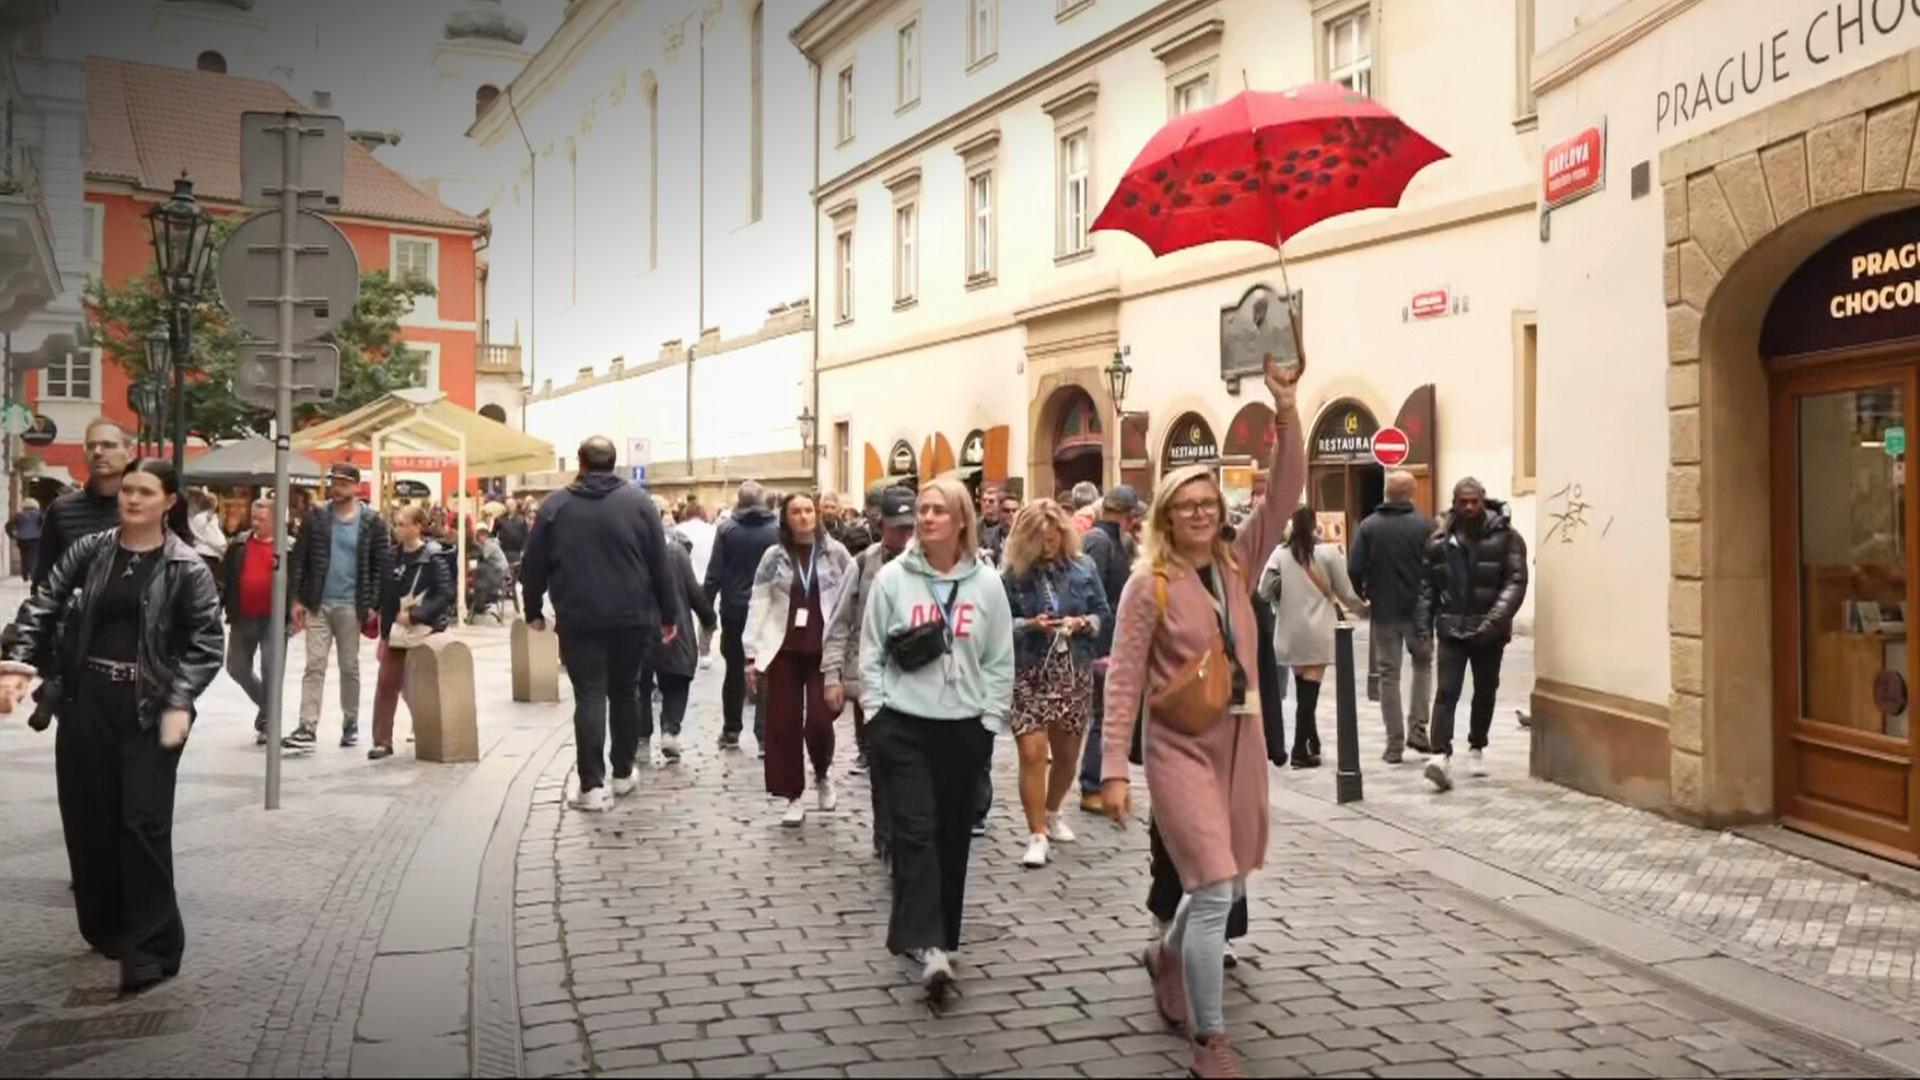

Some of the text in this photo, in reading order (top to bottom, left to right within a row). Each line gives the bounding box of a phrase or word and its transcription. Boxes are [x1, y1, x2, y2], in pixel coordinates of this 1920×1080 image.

[1656, 30, 1790, 133] PRAGUE
[1851, 242, 1920, 280] PRAG
[1318, 436, 1373, 451] RESTAURA
